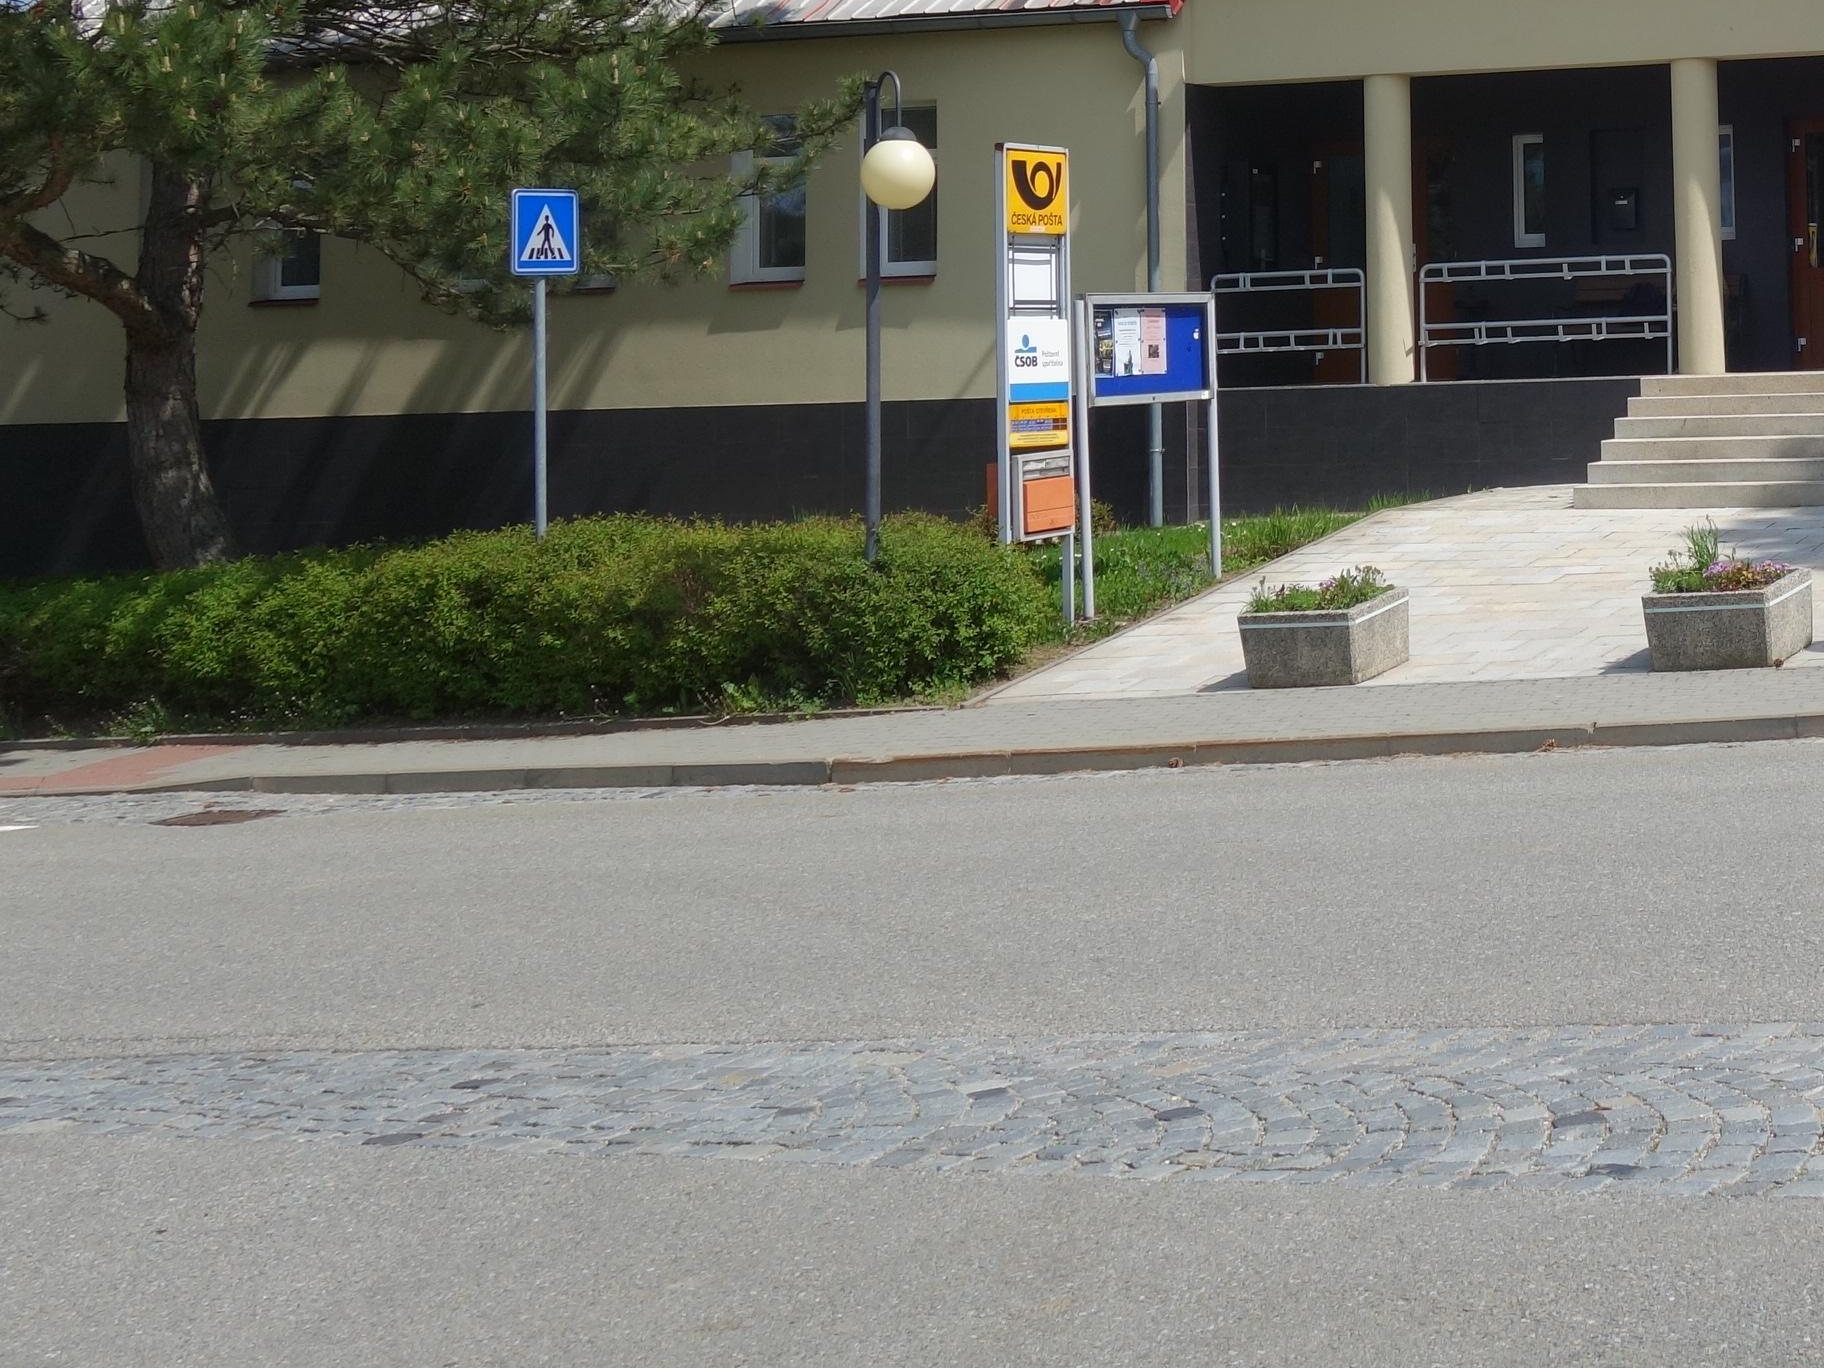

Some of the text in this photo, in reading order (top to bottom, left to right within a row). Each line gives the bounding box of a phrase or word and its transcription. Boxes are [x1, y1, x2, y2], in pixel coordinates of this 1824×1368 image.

[1011, 211, 1063, 226] ČESKÁ POŠTA
[1014, 355, 1038, 368] ČSOB
